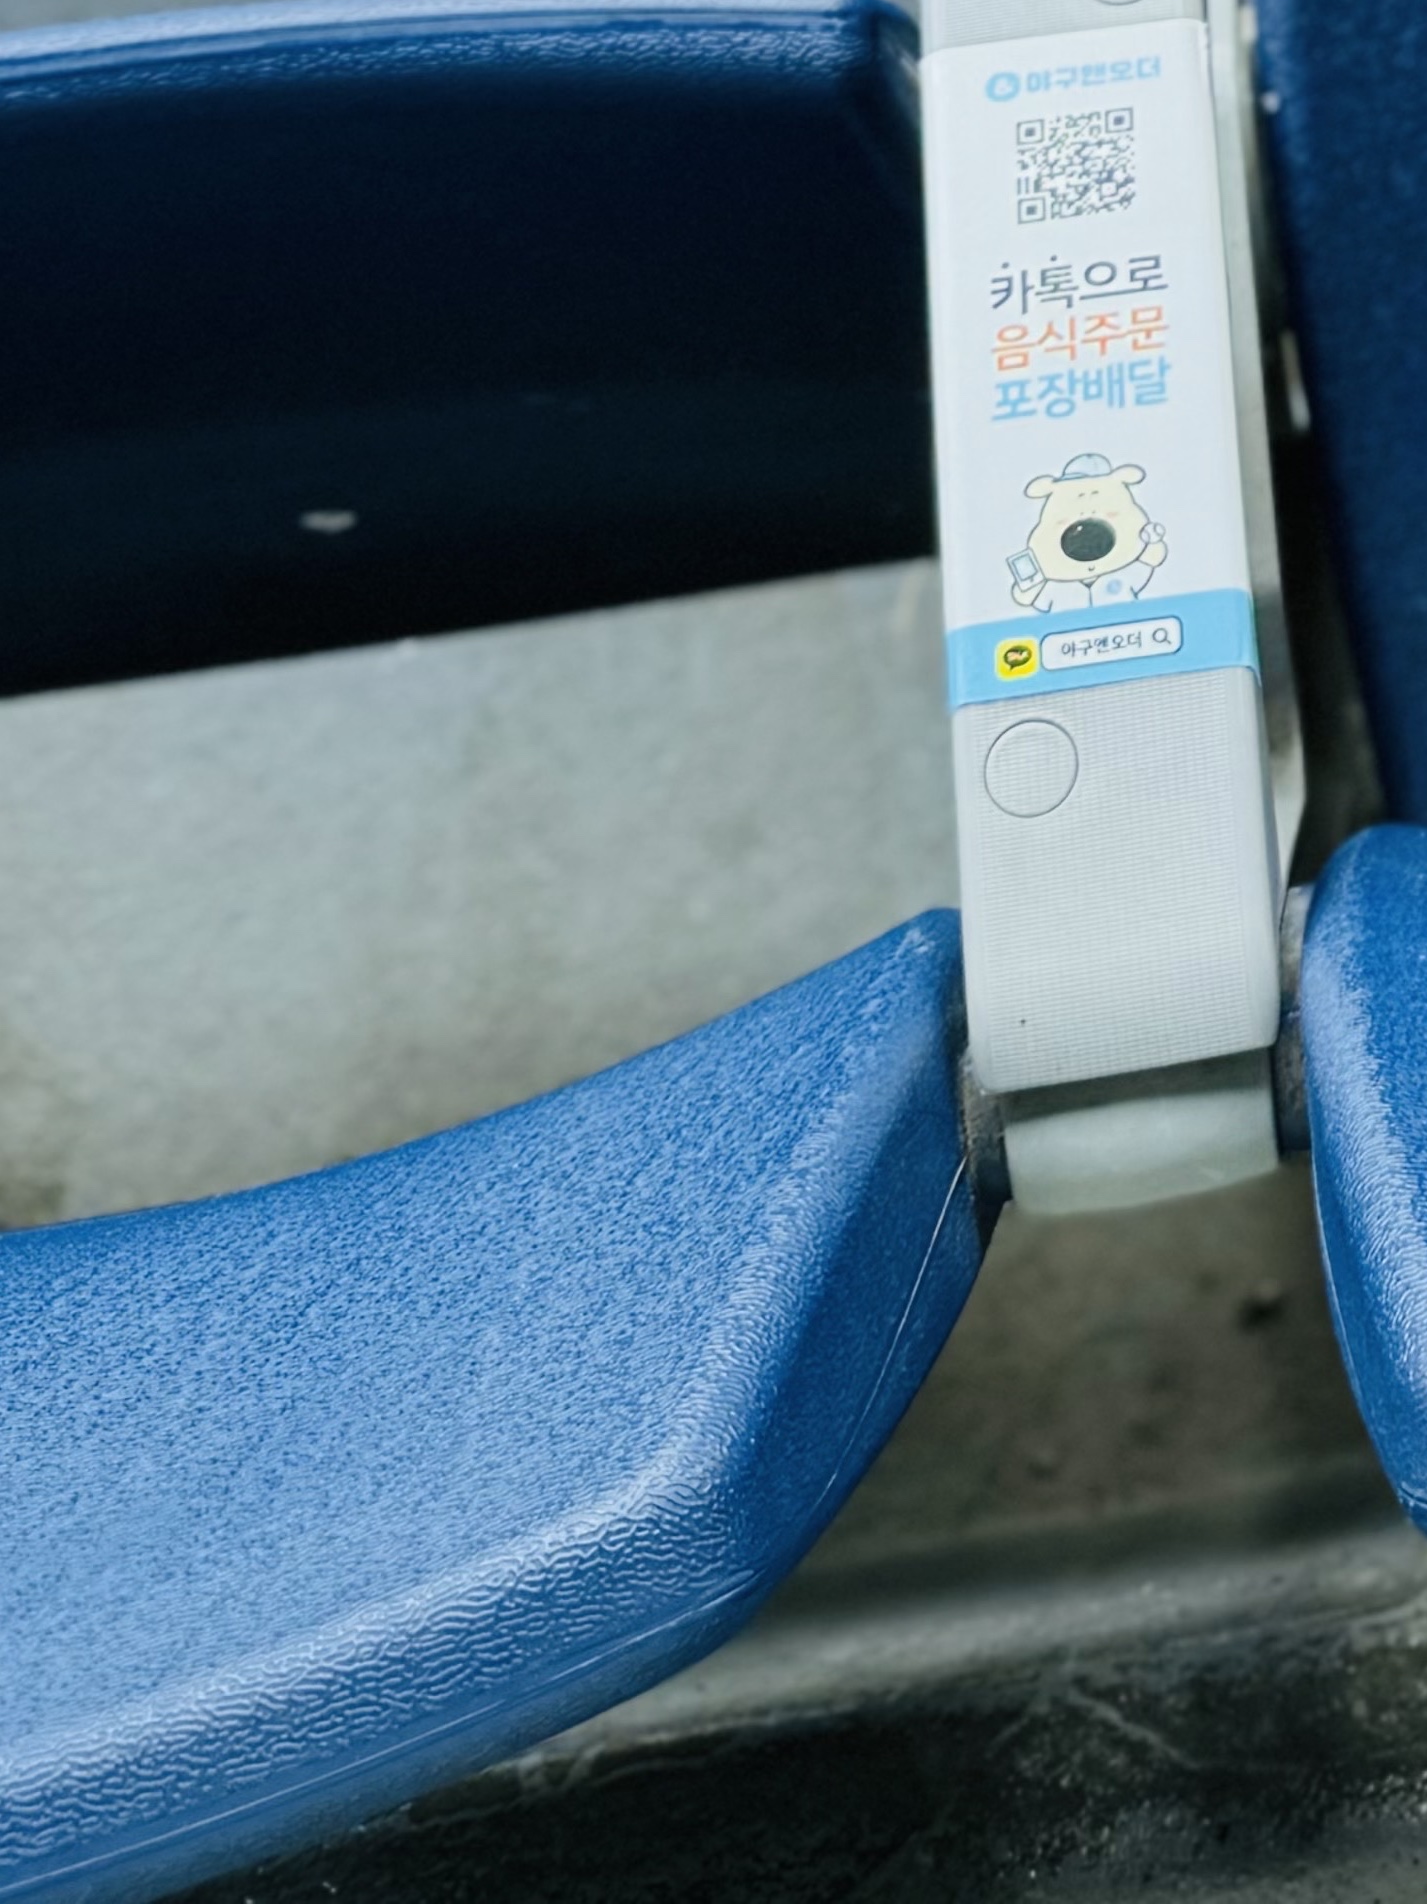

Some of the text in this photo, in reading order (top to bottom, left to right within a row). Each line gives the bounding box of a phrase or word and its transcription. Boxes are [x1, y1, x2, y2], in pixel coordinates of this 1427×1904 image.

[990, 254, 1170, 316] 카톡으로
[990, 305, 1171, 372] 음식주문
[990, 355, 1173, 422] 포장배달
